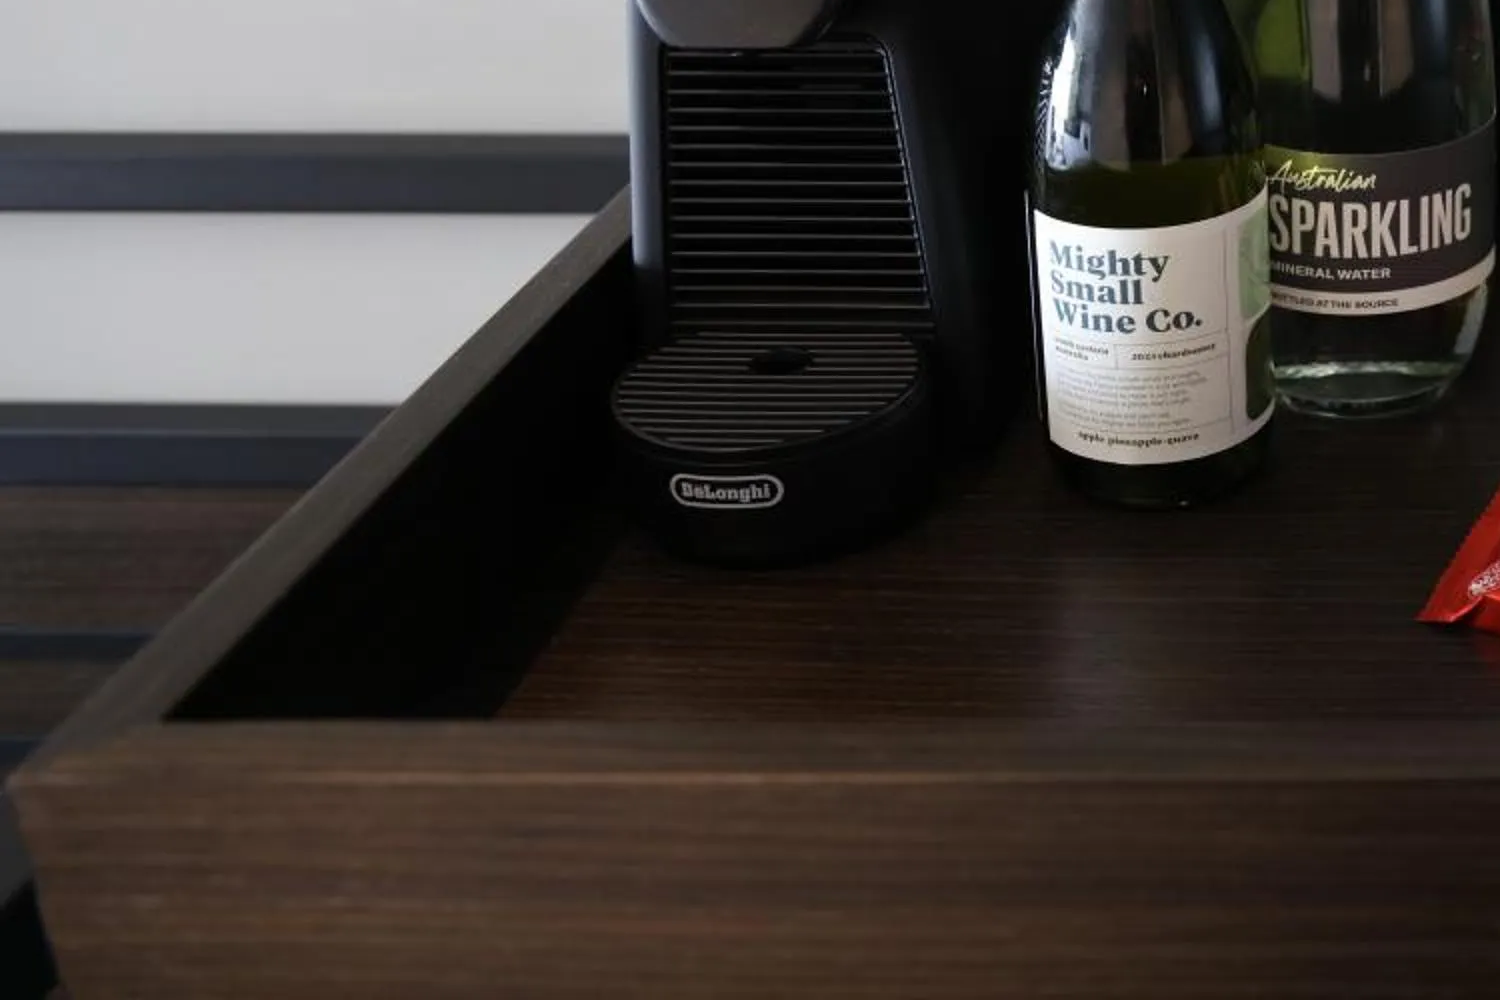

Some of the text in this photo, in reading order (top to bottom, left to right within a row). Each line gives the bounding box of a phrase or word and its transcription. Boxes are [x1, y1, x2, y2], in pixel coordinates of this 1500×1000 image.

[1267, 159, 1377, 193] Australian
[1270, 183, 1472, 260] SPARKLING
[1050, 239, 1170, 284] Mighty
[1337, 267, 1392, 281] WATER
[1050, 268, 1144, 306] Small
[1331, 300, 1352, 309] THE
[1354, 299, 1398, 309] SOURCE
[1053, 296, 1204, 335] Wine Co.
[681, 480, 771, 503] DeLonghi
